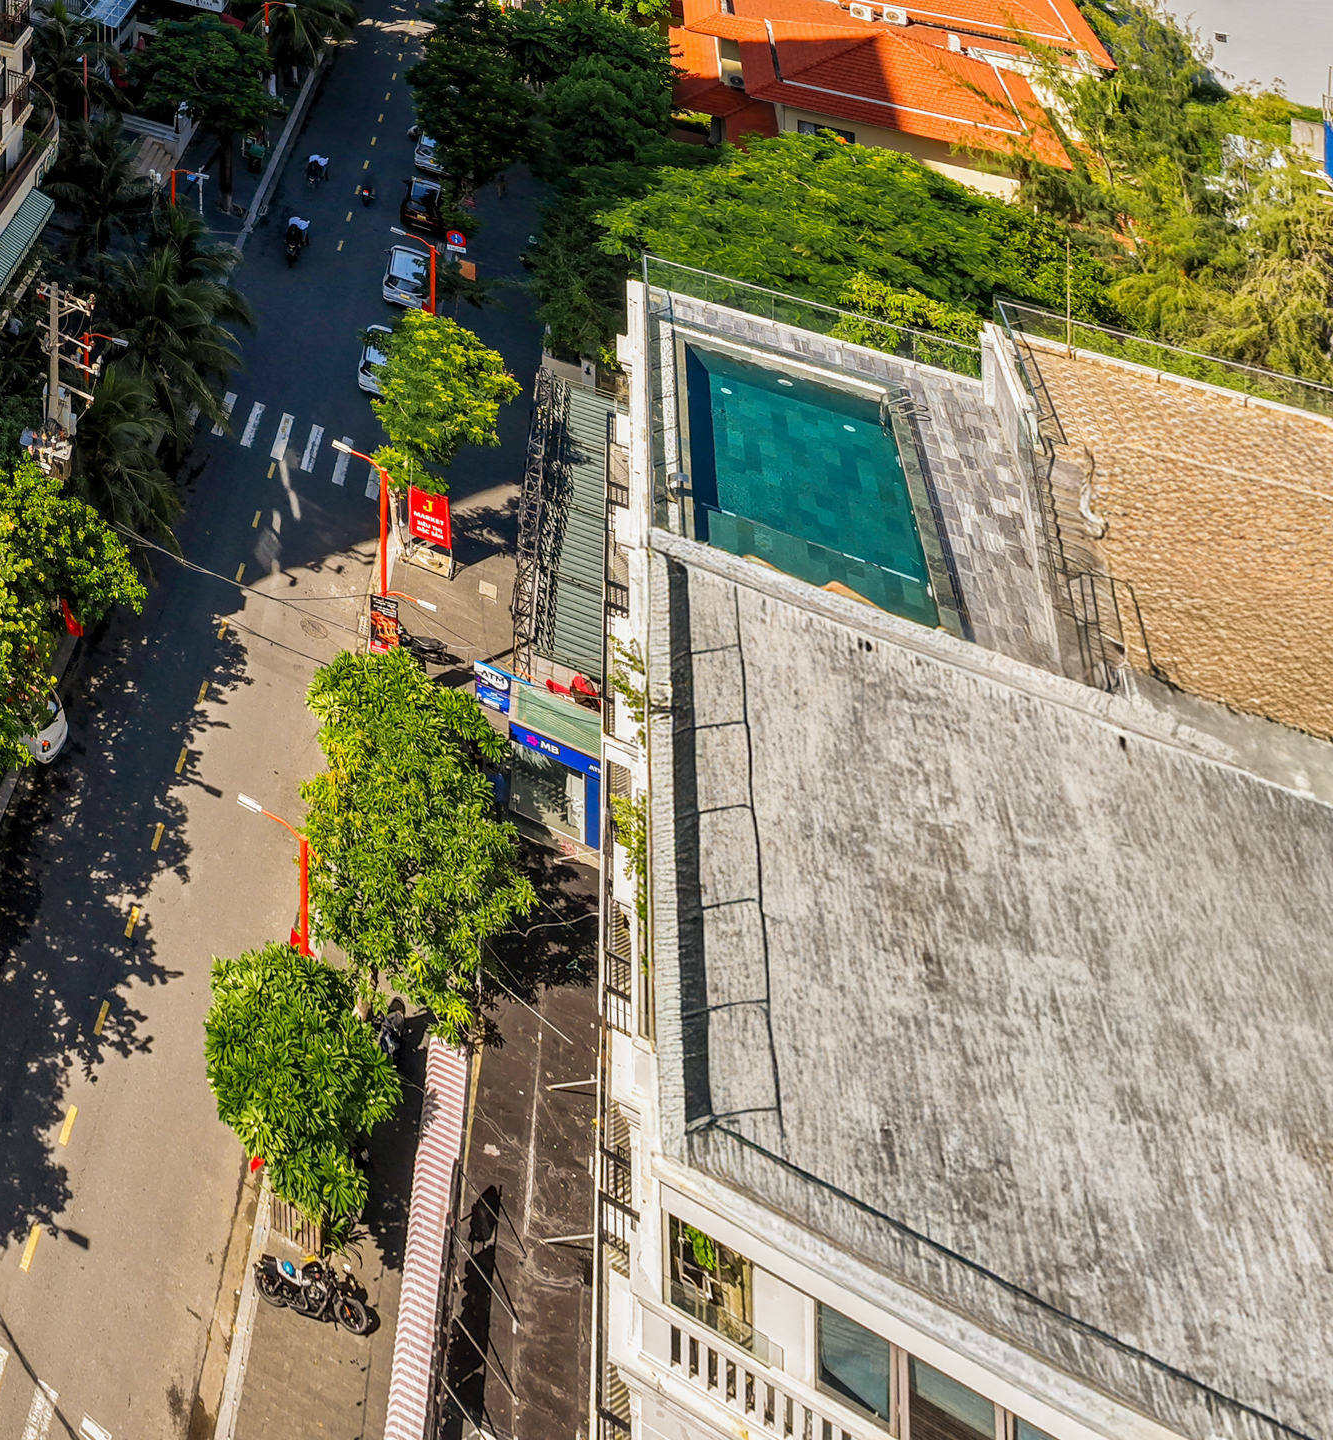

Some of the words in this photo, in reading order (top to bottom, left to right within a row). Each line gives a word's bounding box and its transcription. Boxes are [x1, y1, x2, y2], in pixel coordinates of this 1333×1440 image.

[422, 499, 434, 513] J
[413, 510, 445, 527] MARKET
[481, 669, 505, 685] ATM
[540, 740, 561, 756] MB
